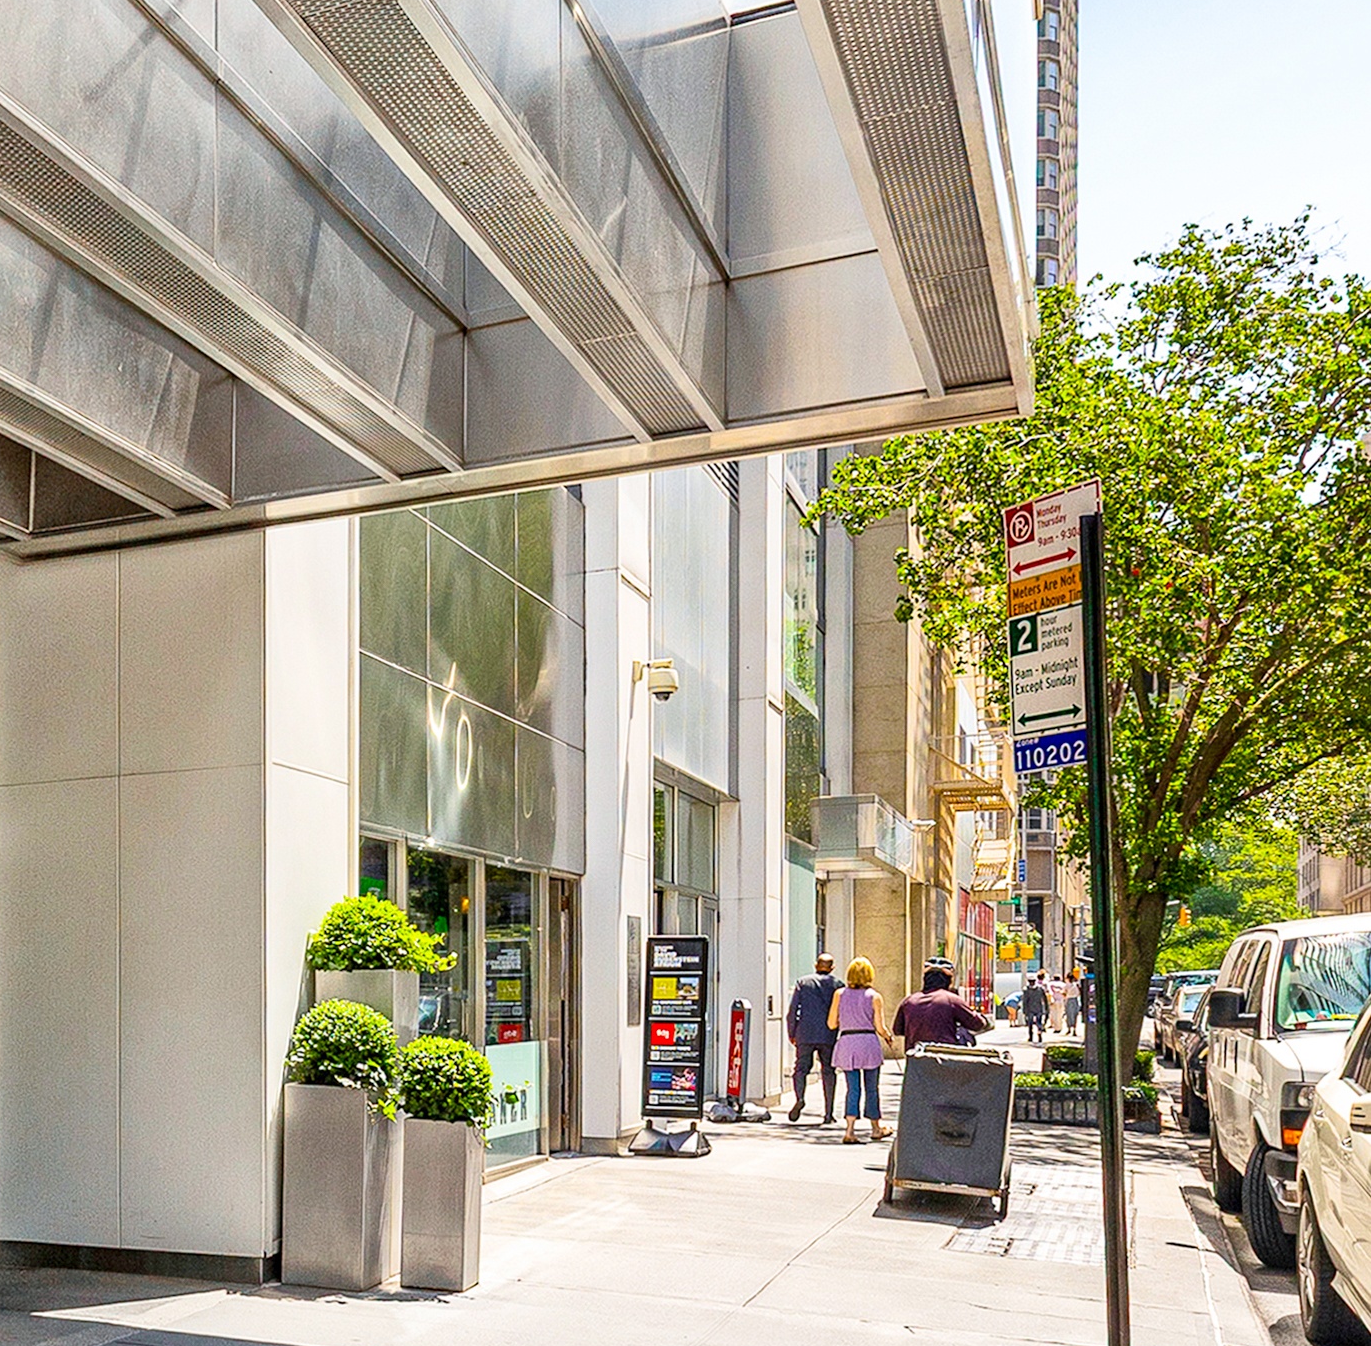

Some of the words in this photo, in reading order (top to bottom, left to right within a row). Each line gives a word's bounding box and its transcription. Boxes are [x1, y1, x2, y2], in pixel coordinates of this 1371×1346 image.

[1037, 504, 1062, 518] Monday
[1038, 514, 1067, 529] Thursday
[1038, 536, 1054, 548] 9am
[1012, 584, 1041, 600] Meters
[1044, 580, 1058, 592] Are
[1060, 573, 1076, 587] Not
[1013, 599, 1037, 615] Effect
[1040, 594, 1066, 609] Above
[1040, 615, 1058, 627] hour
[1041, 622, 1073, 638] metered
[1016, 620, 1032, 652] 2
[1041, 637, 1069, 652] parking
[1015, 668, 1033, 680] 9am
[1041, 656, 1078, 674] Midnight
[1015, 679, 1043, 695] Except
[1045, 674, 1077, 690] Sunday
[1017, 740, 1085, 770] 110202
